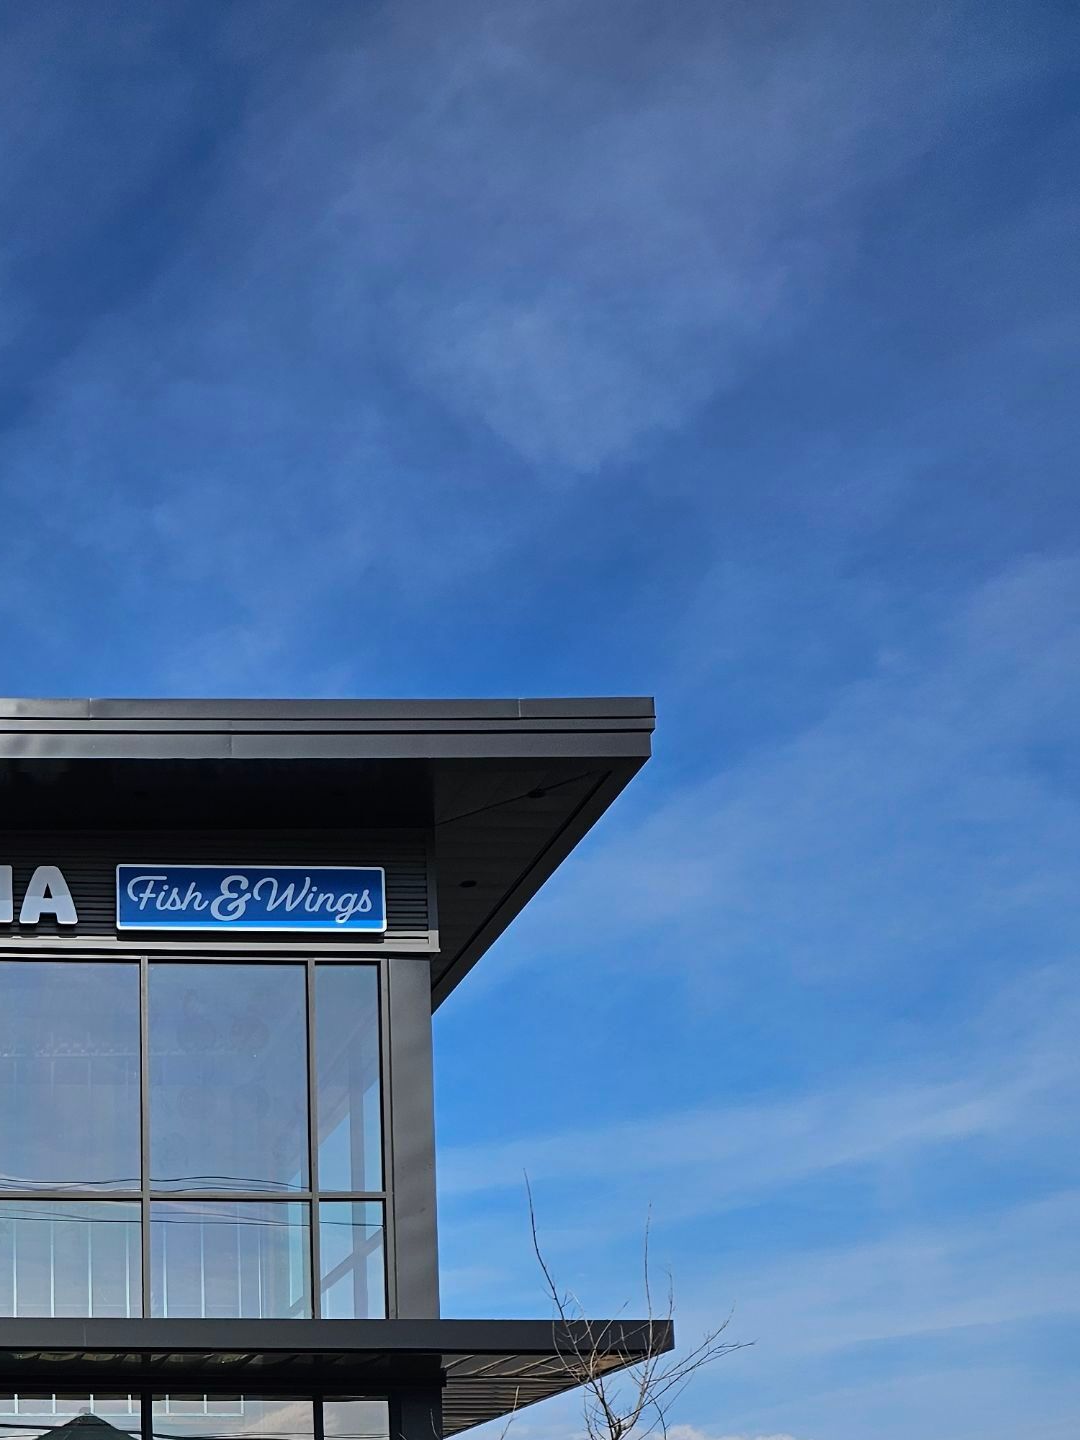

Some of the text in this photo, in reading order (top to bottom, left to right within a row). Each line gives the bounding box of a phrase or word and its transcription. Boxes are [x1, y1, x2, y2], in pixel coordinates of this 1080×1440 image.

[127, 874, 373, 924] Fish & Wings
